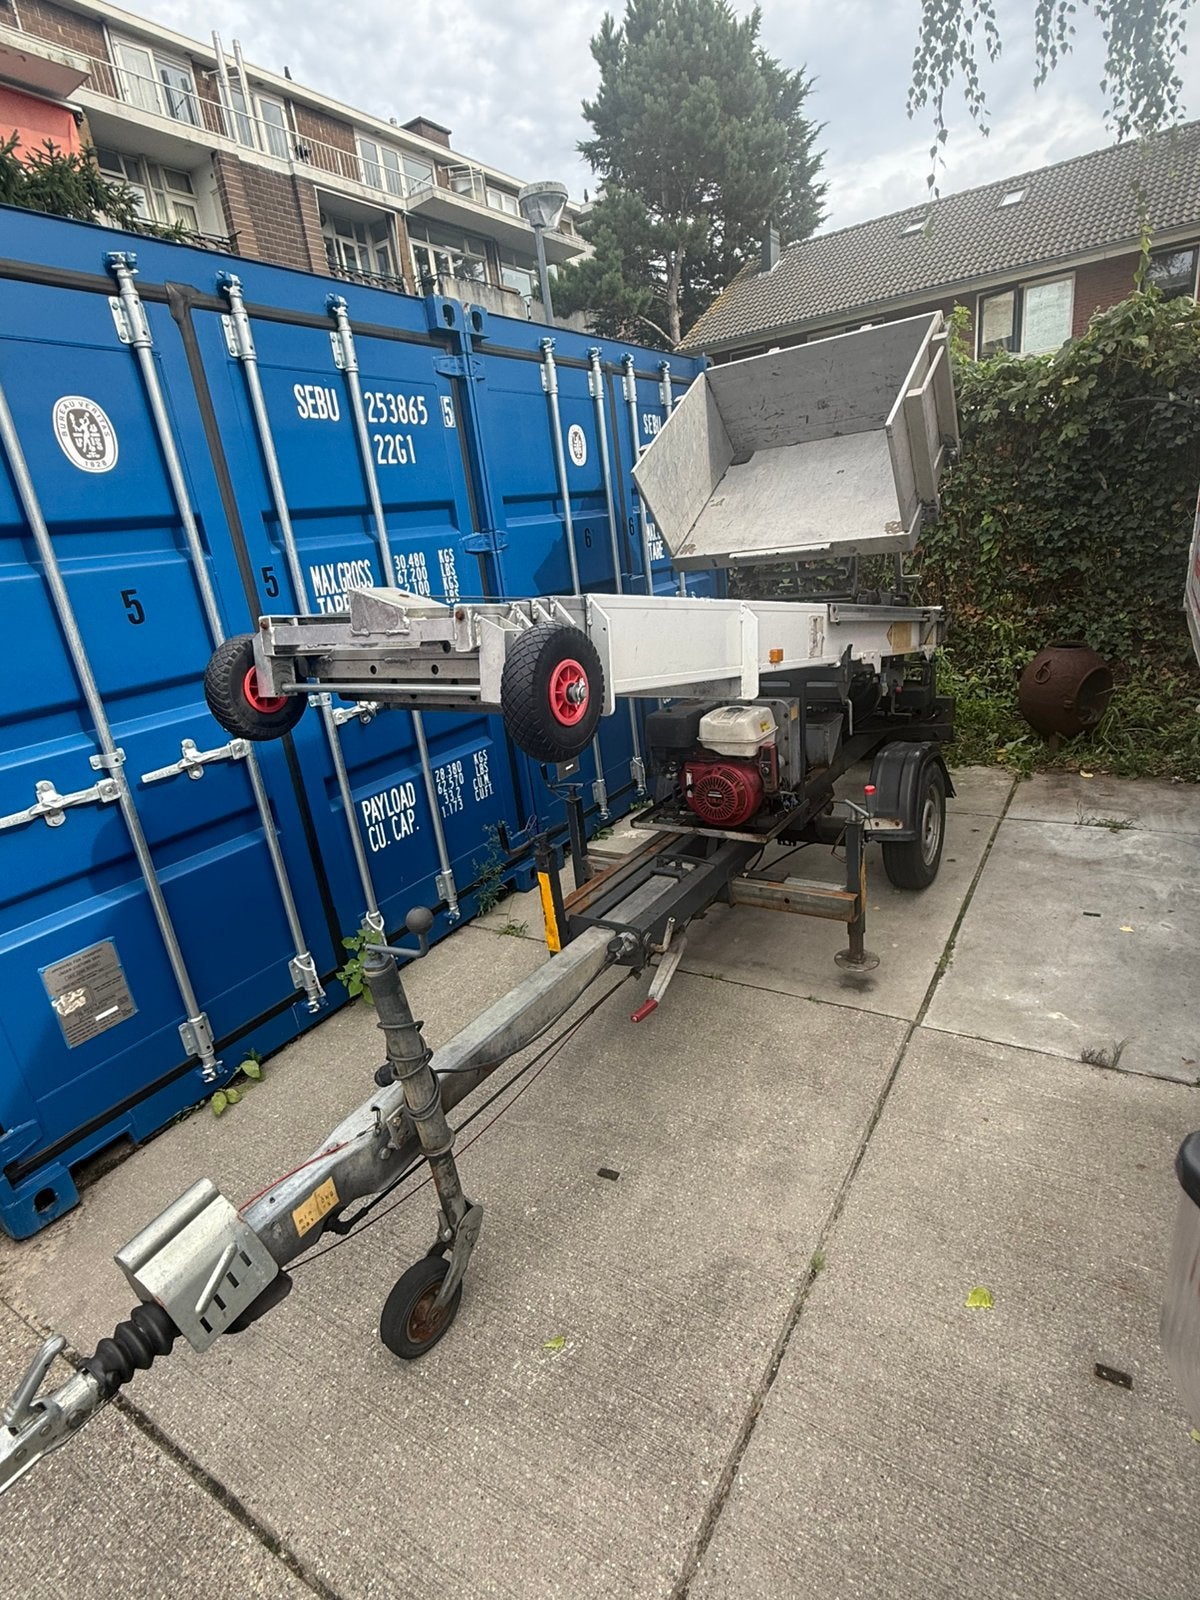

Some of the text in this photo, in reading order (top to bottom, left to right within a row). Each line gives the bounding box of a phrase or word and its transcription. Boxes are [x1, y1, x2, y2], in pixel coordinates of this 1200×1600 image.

[59, 401, 111, 438] BUREAU VERITAS
[293, 383, 455, 427] SEBU 253865 5
[85, 460, 108, 468] 1828
[373, 433, 417, 465] 22G1
[584, 527, 592, 548] 6
[628, 516, 635, 536] 6
[393, 551, 426, 570] 30.480
[438, 547, 455, 564] KGS
[397, 562, 456, 585] 67.200 LBS
[261, 565, 280, 598] 5
[442, 575, 460, 591] KGS
[120, 588, 146, 625] 5
[434, 749, 488, 783] 28.380 KGS
[437, 761, 489, 795] 62.570 LBS
[361, 781, 416, 827] PAYLOAD
[441, 798, 464, 818] 1.173
[443, 786, 462, 805] 33.2
[368, 809, 420, 852] CU. CAP.
